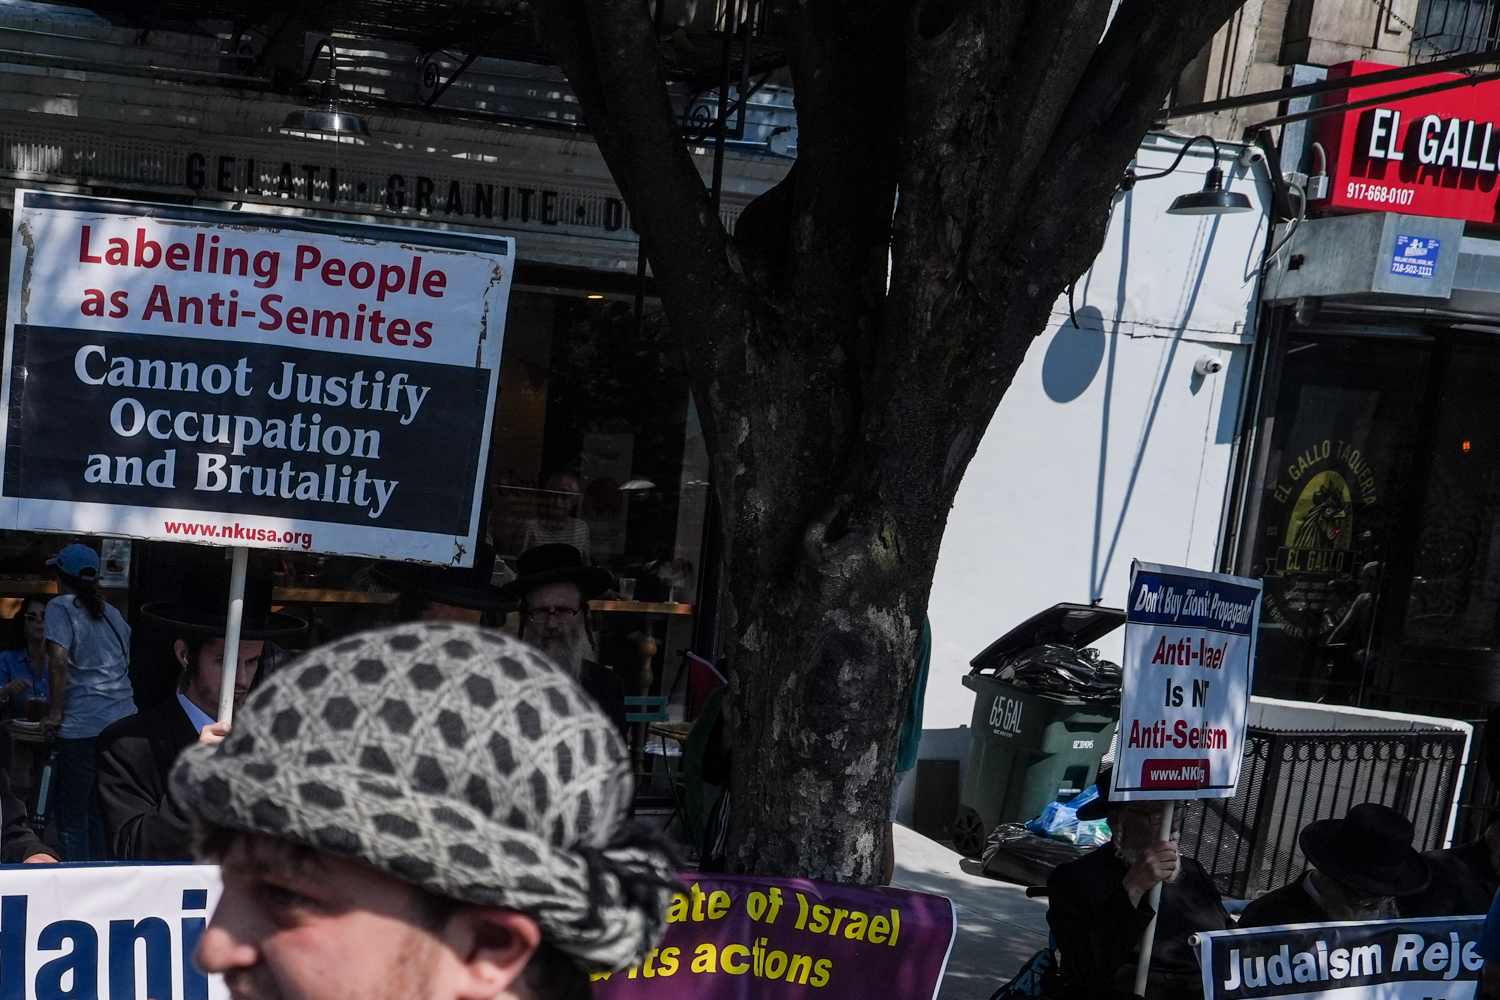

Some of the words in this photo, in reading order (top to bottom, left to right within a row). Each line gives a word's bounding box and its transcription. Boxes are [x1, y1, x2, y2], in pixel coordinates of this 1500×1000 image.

[1368, 108, 1404, 160] EL
[1418, 114, 1500, 171] GALL
[186, 152, 338, 204] GELATI
[387, 174, 558, 225] GRANITE
[1347, 182, 1414, 205] 917-668-0107
[79, 224, 281, 290] Labeling
[295, 244, 447, 302] People
[80, 286, 129, 320] as
[142, 283, 434, 350] Anti-Semites
[74, 343, 254, 397] Cannot
[268, 360, 431, 426] Justify
[109, 397, 382, 461] Occupation
[83, 448, 176, 490] and
[195, 451, 399, 518] Brutality
[1273, 484, 1292, 504] EL
[1288, 439, 1331, 481] GALLO
[164, 516, 312, 549] www.nkusa.org
[1286, 549, 1301, 570] EL
[1307, 551, 1345, 573] GALLO
[1134, 584, 1164, 613] Don't
[1163, 587, 1182, 622] Buy
[989, 696, 1005, 728] 65
[1003, 698, 1023, 734] GAL
[1165, 678, 1183, 708] Is
[665, 882, 731, 924] ate
[747, 886, 784, 924] of
[795, 892, 901, 947] Israel
[690, 936, 833, 988] actions
[1224, 940, 1382, 992] Judaism
